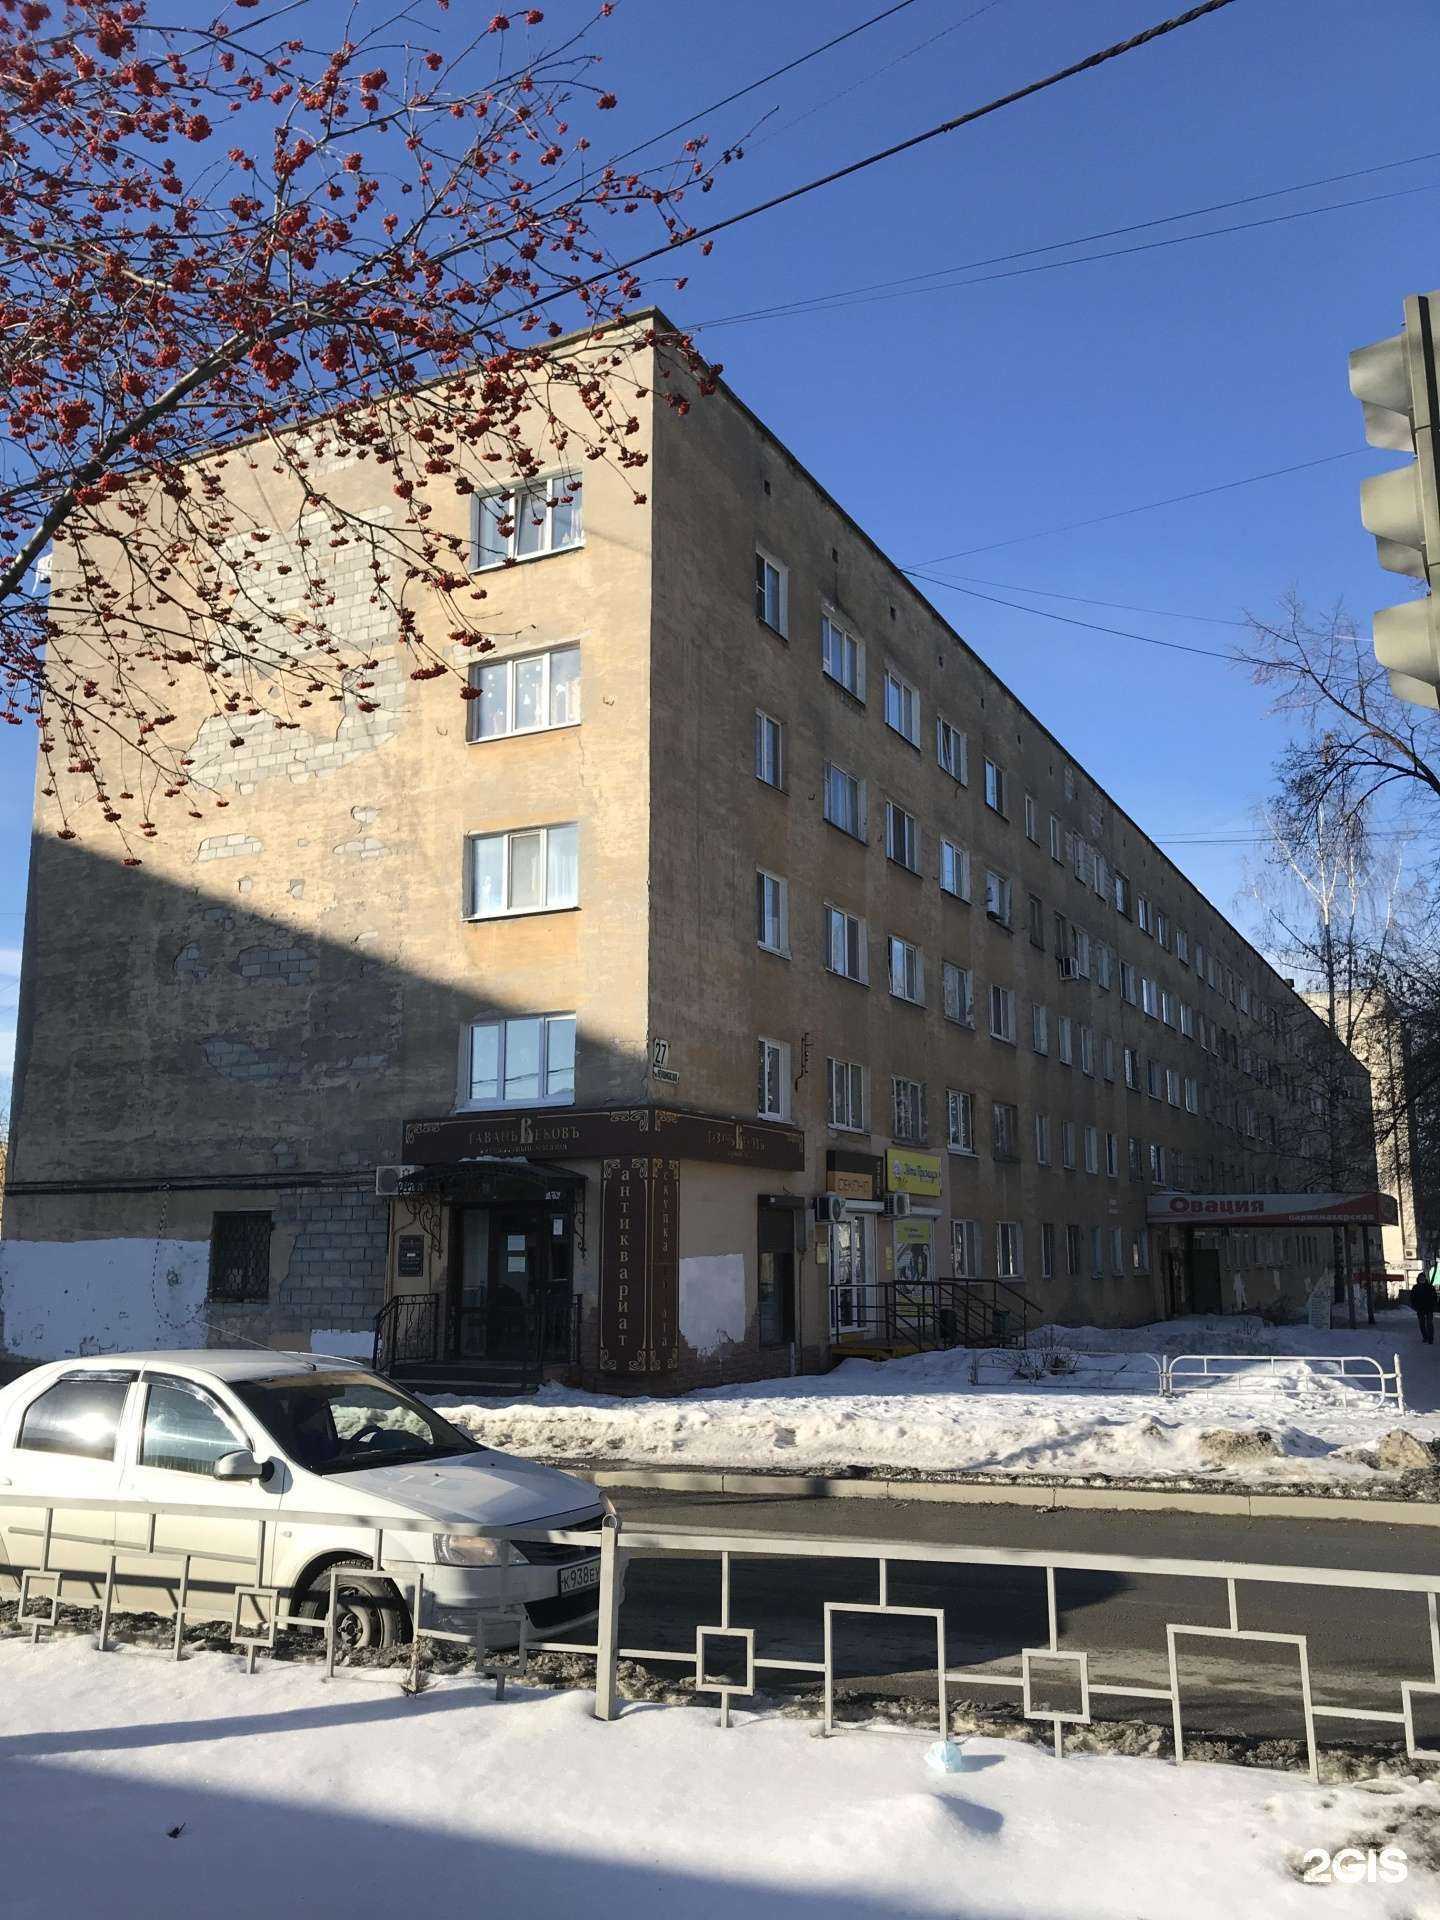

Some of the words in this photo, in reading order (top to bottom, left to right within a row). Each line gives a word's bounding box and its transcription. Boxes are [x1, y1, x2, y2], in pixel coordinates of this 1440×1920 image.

[655, 1042, 667, 1064] 27
[1169, 1197, 1264, 1215] Овация
[618, 1169, 631, 1346] антиквариат
